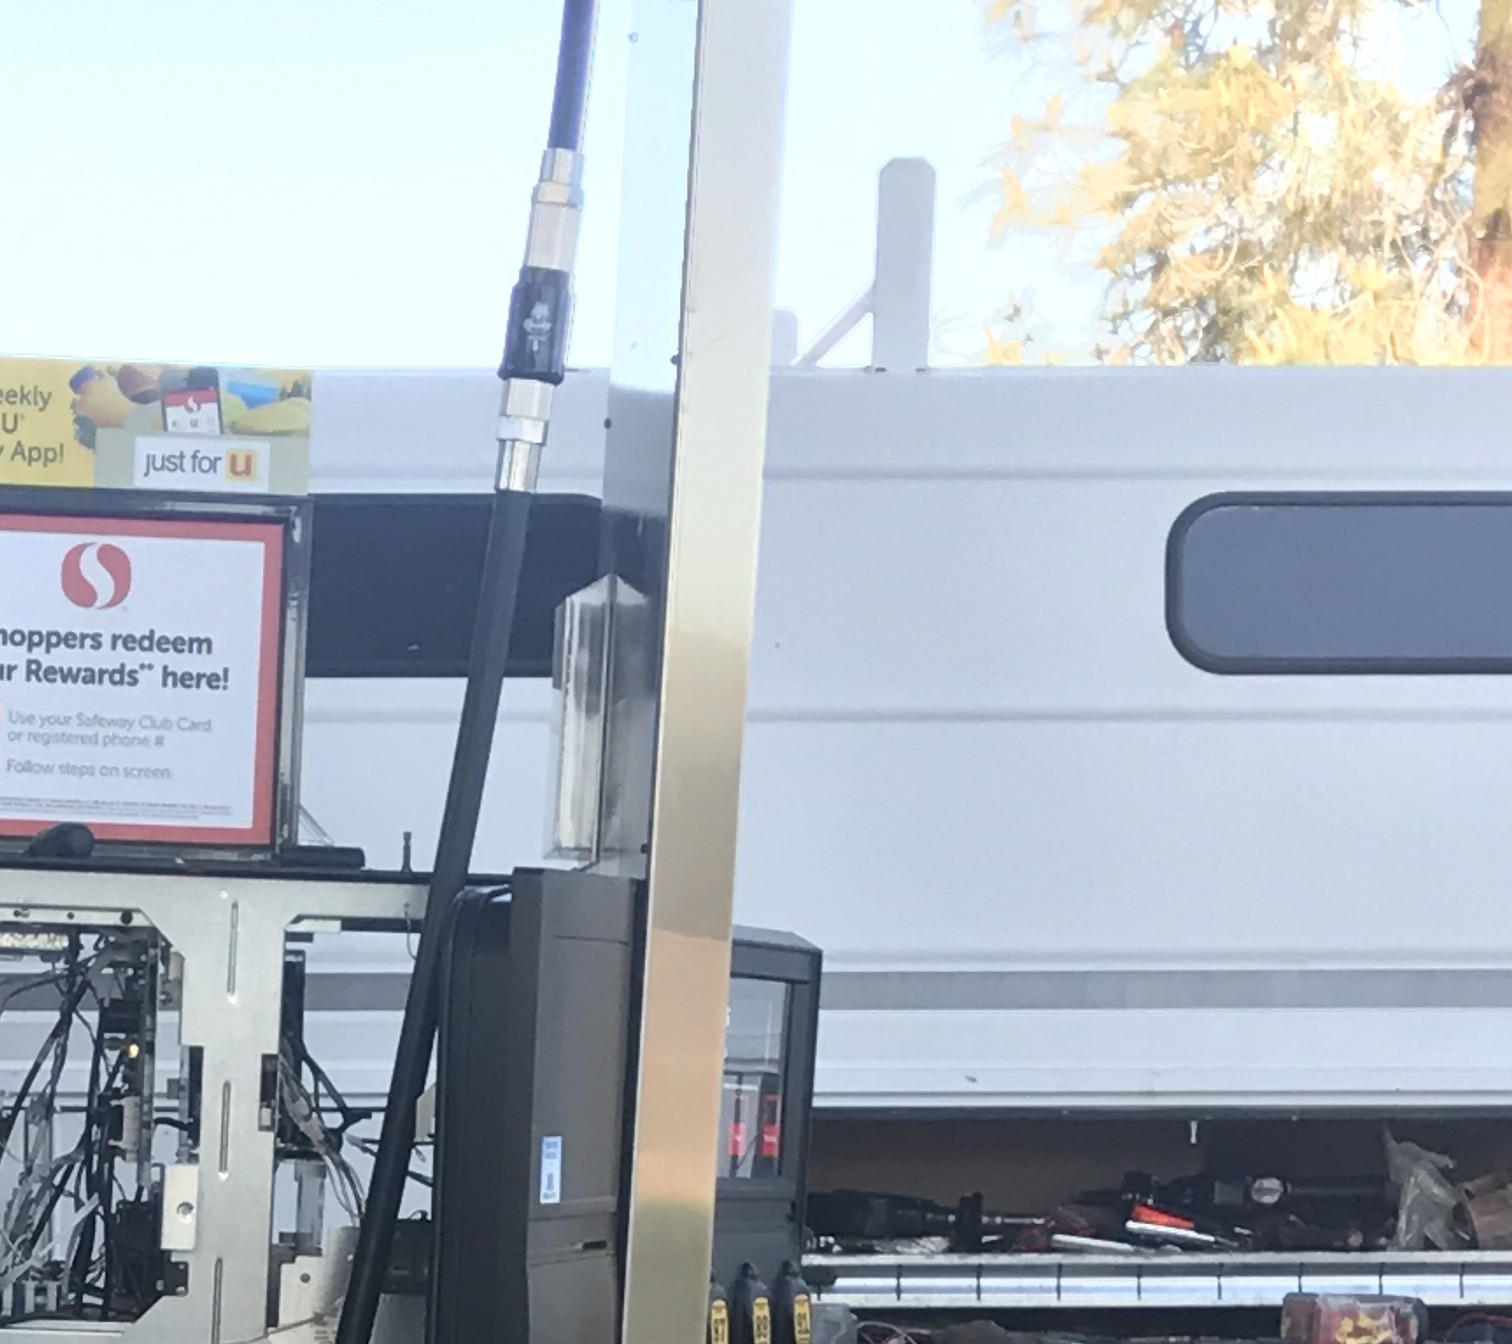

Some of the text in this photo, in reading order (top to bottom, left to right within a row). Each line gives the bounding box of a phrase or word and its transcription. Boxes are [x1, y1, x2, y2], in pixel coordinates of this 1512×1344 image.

[10, 440, 65, 468] App!
[143, 450, 185, 478] just
[190, 449, 223, 474] for
[110, 628, 214, 655] redeem
[161, 665, 230, 691] here!
[8, 710, 212, 733] Use your Safeway Club Card
[7, 732, 22, 743] or
[27, 730, 99, 747] registered
[102, 733, 150, 748] phone
[6, 759, 171, 780] Follow steps on screen
